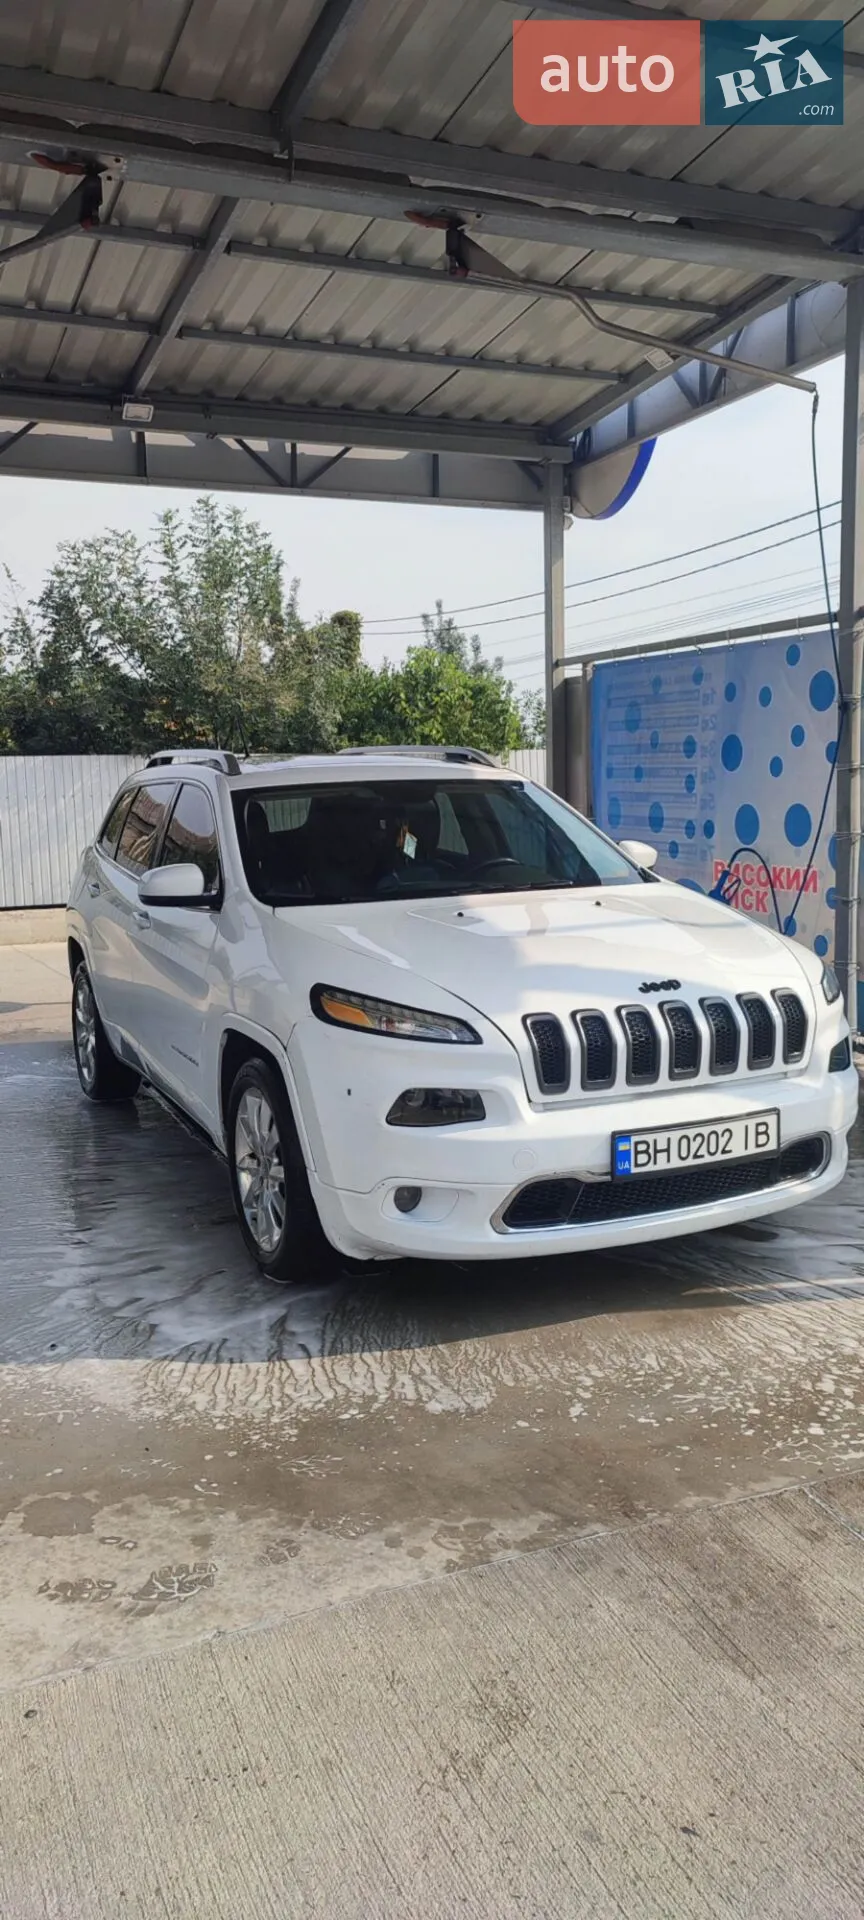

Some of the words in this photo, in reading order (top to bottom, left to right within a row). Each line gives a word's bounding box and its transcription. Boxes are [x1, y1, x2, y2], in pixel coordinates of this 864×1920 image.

[722, 887, 768, 913] ИСК
[637, 979, 682, 994] Jeep
[633, 1136, 671, 1169] BH
[677, 1127, 734, 1162] 0202
[617, 1160, 631, 1170] UA
